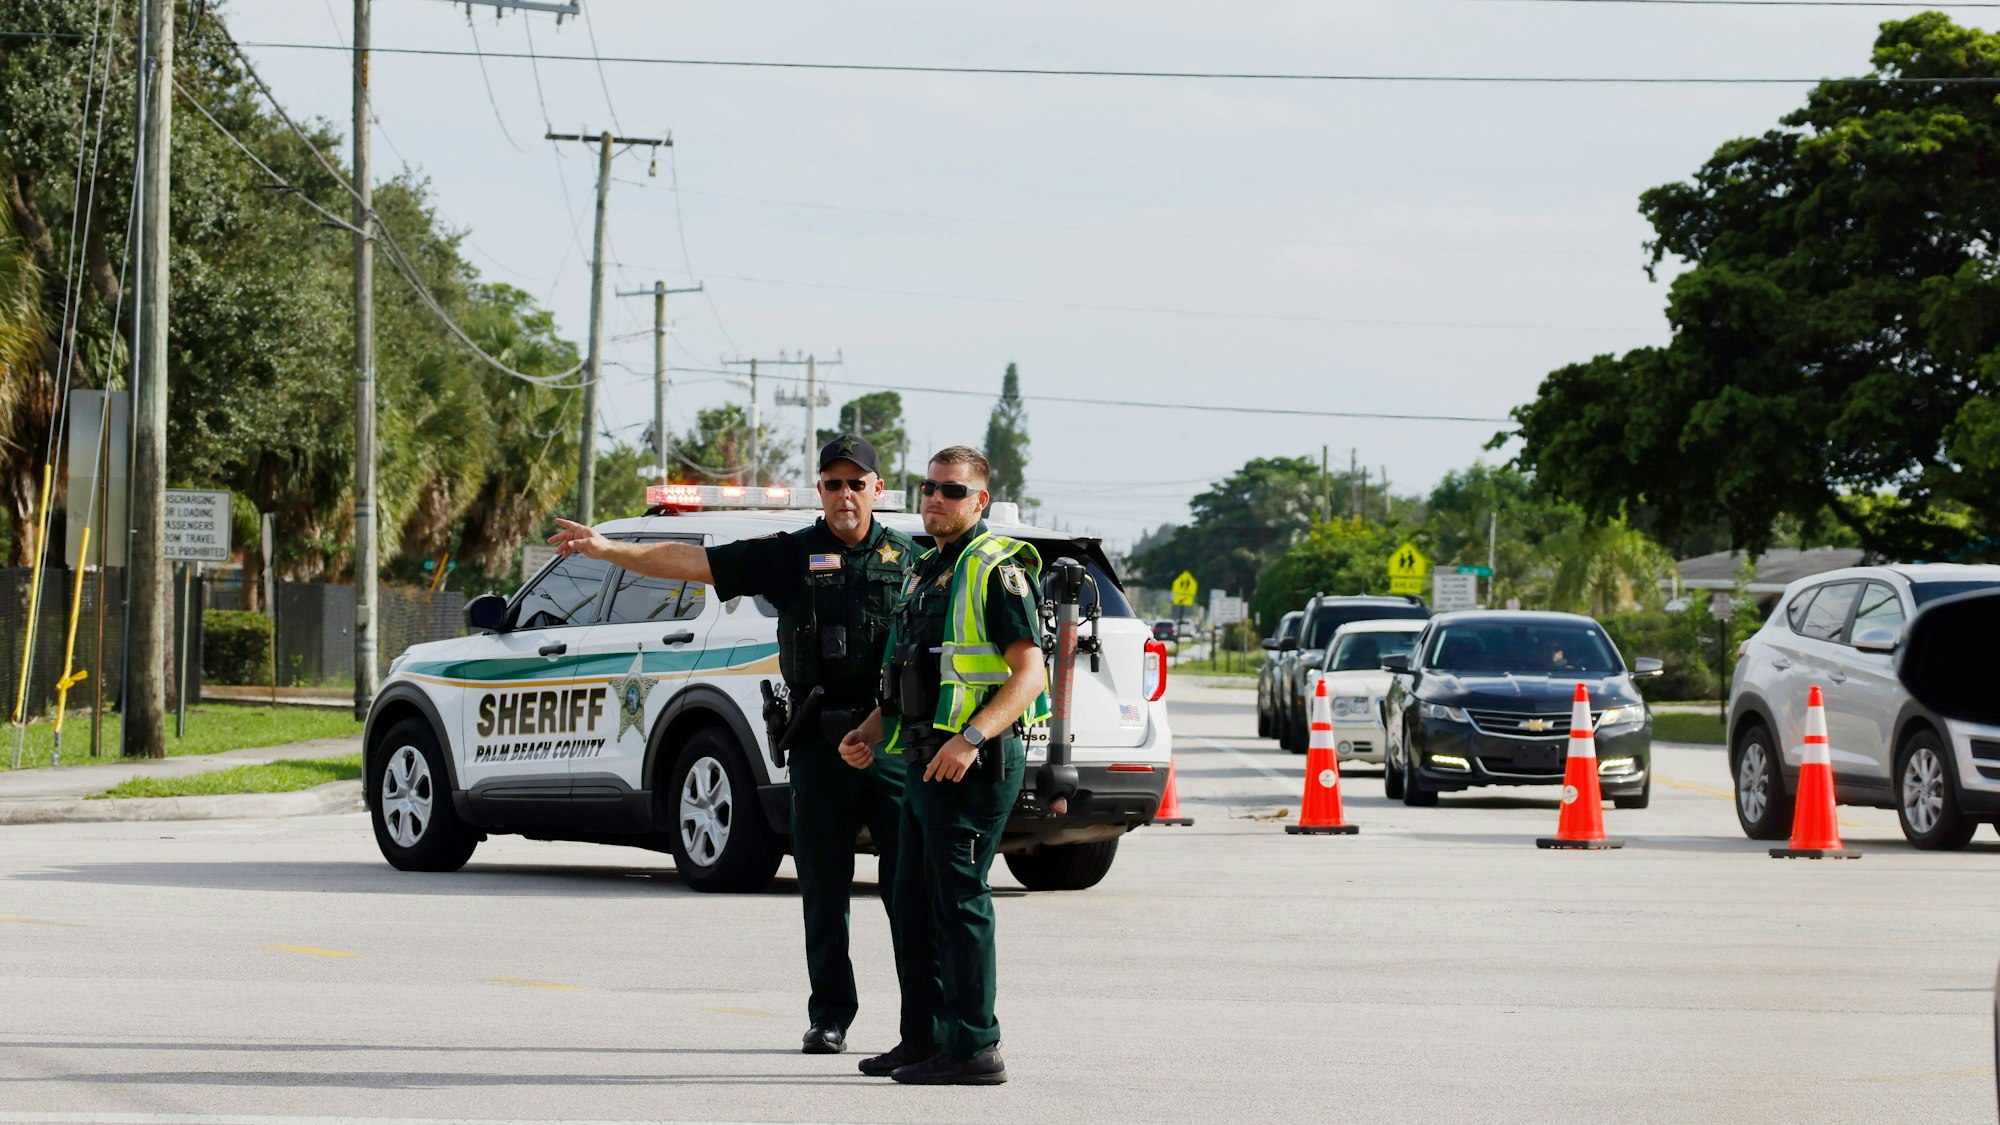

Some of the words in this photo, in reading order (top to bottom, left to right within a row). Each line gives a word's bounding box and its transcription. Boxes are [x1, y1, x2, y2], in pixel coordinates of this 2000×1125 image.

[166, 494, 216, 505] ISCHARGING
[178, 507, 214, 518] LOADING
[165, 521, 214, 531] ASSENGERS
[186, 533, 216, 544] TRAVEL
[179, 546, 226, 557] PROHIBITED
[476, 687, 607, 738] SHERIFF
[474, 744, 510, 762] PALM
[510, 741, 552, 761] BEACH
[552, 739, 606, 759] COUNTY
